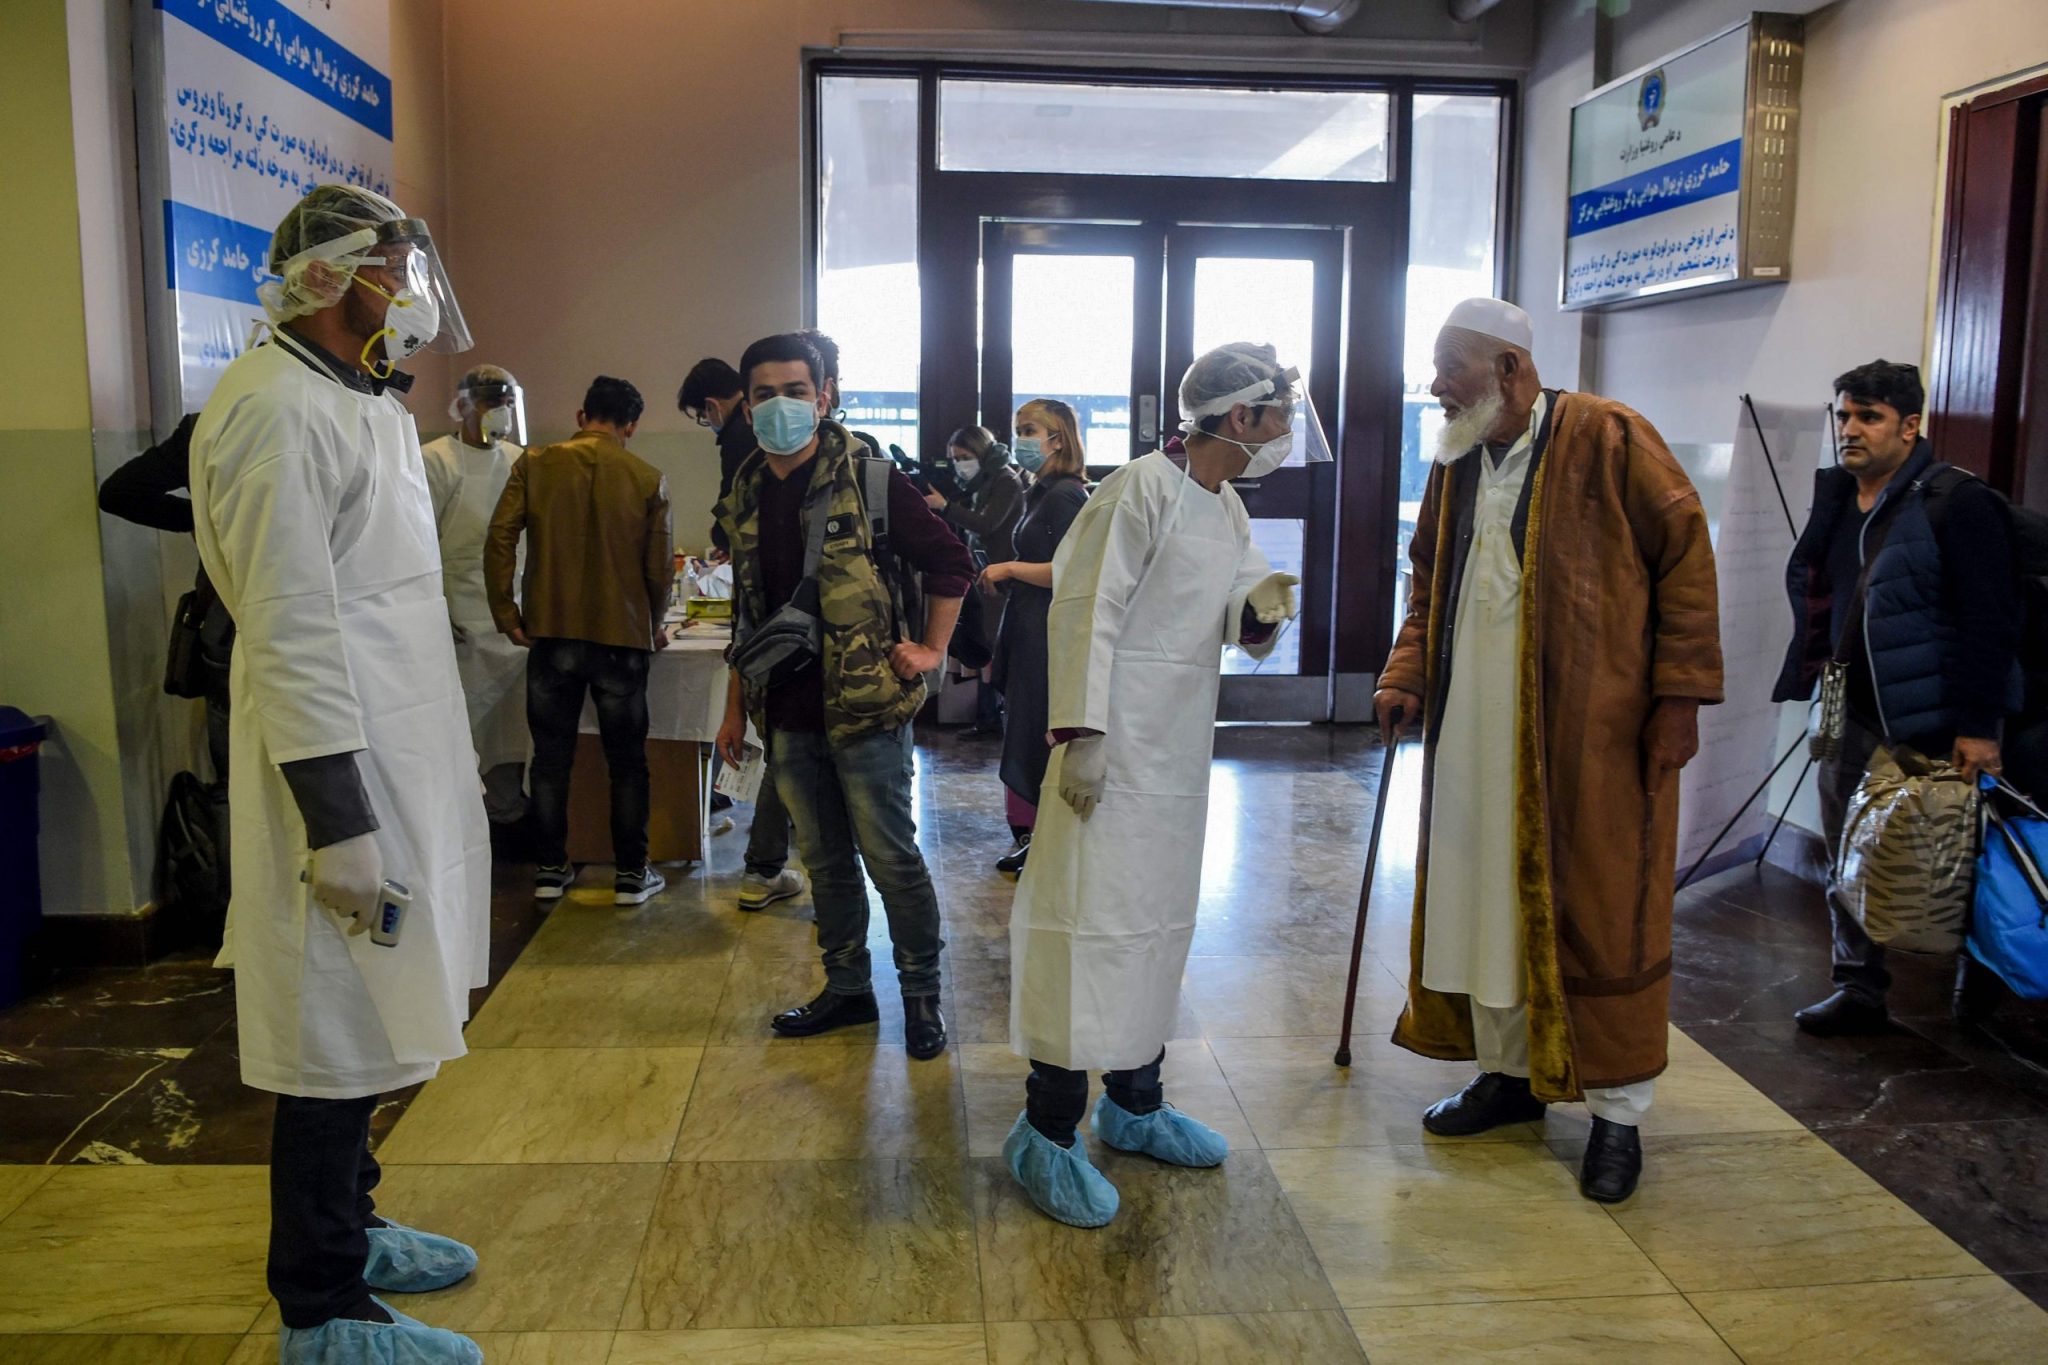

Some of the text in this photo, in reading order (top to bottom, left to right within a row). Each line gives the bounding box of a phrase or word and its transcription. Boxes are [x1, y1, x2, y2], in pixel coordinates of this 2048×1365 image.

[361, 82, 380, 107] حامد
[1707, 156, 1730, 179] حامد
[222, 242, 250, 270] حامد
